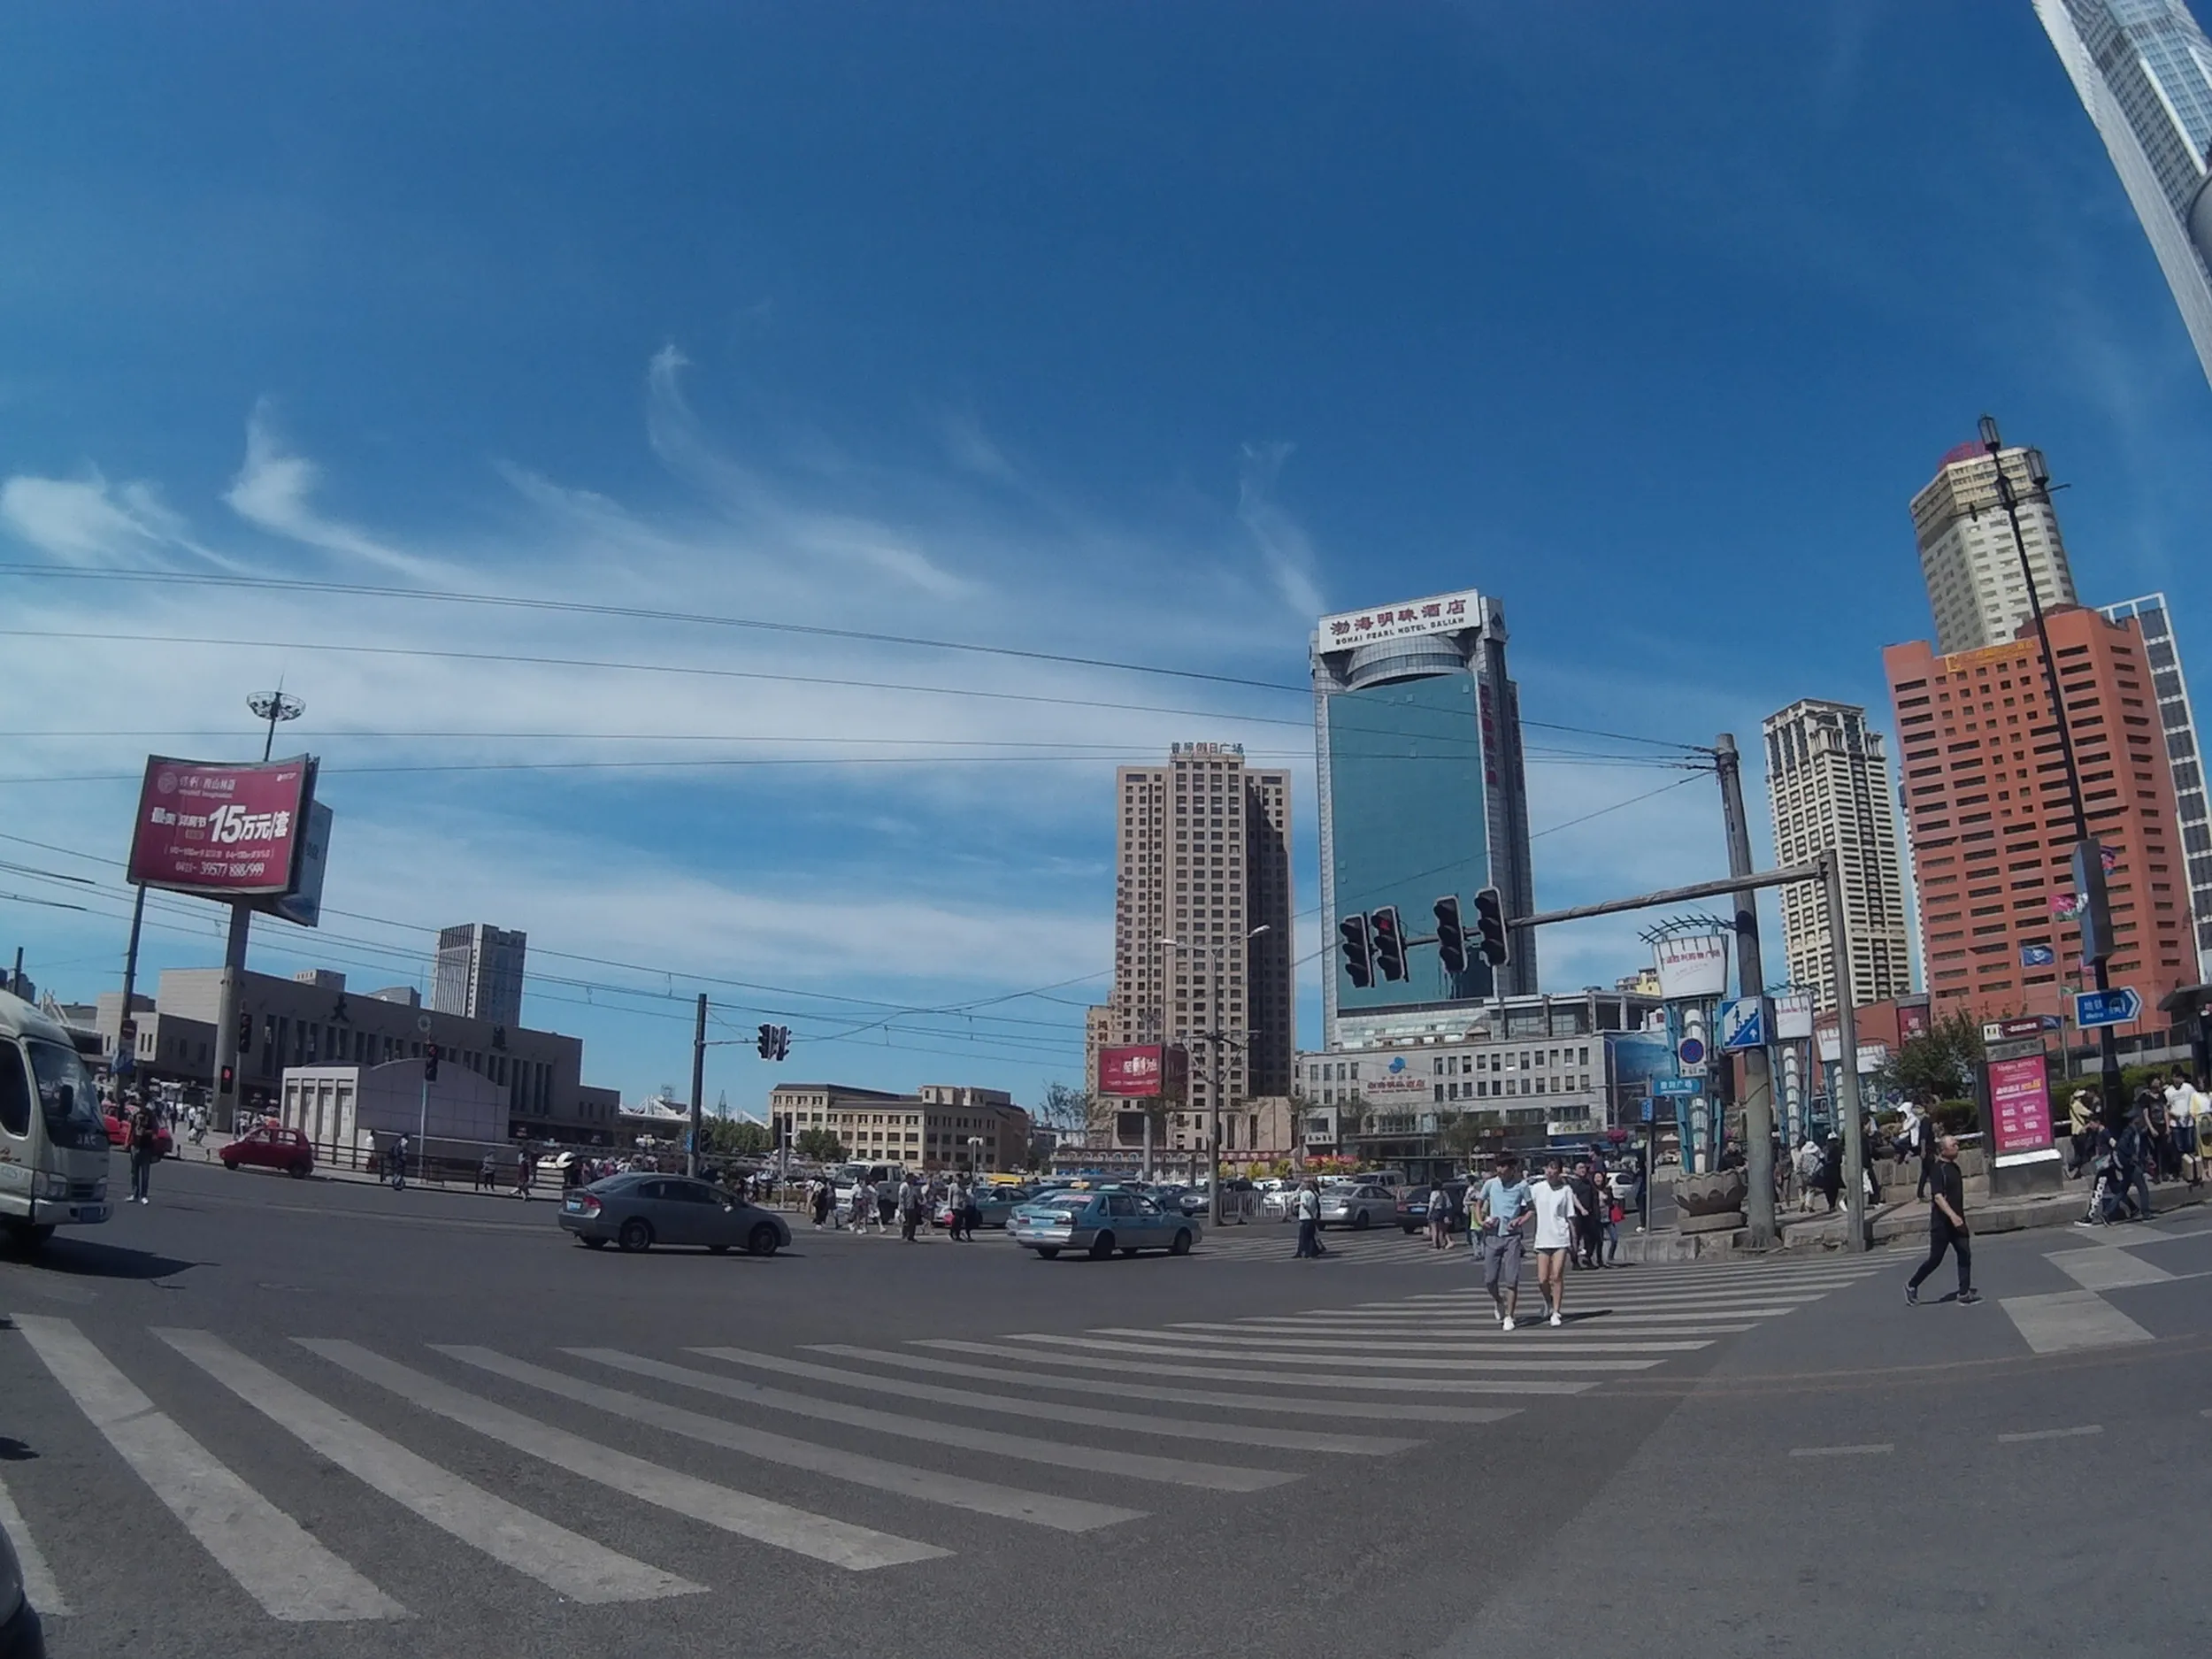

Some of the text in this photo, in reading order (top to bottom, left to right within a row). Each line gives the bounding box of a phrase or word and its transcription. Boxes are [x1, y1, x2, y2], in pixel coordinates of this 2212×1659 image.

[1330, 599, 1466, 636] 渤海明珠酒店
[1335, 617, 1464, 645] BOHAI PEARL HOTEL DALIAN
